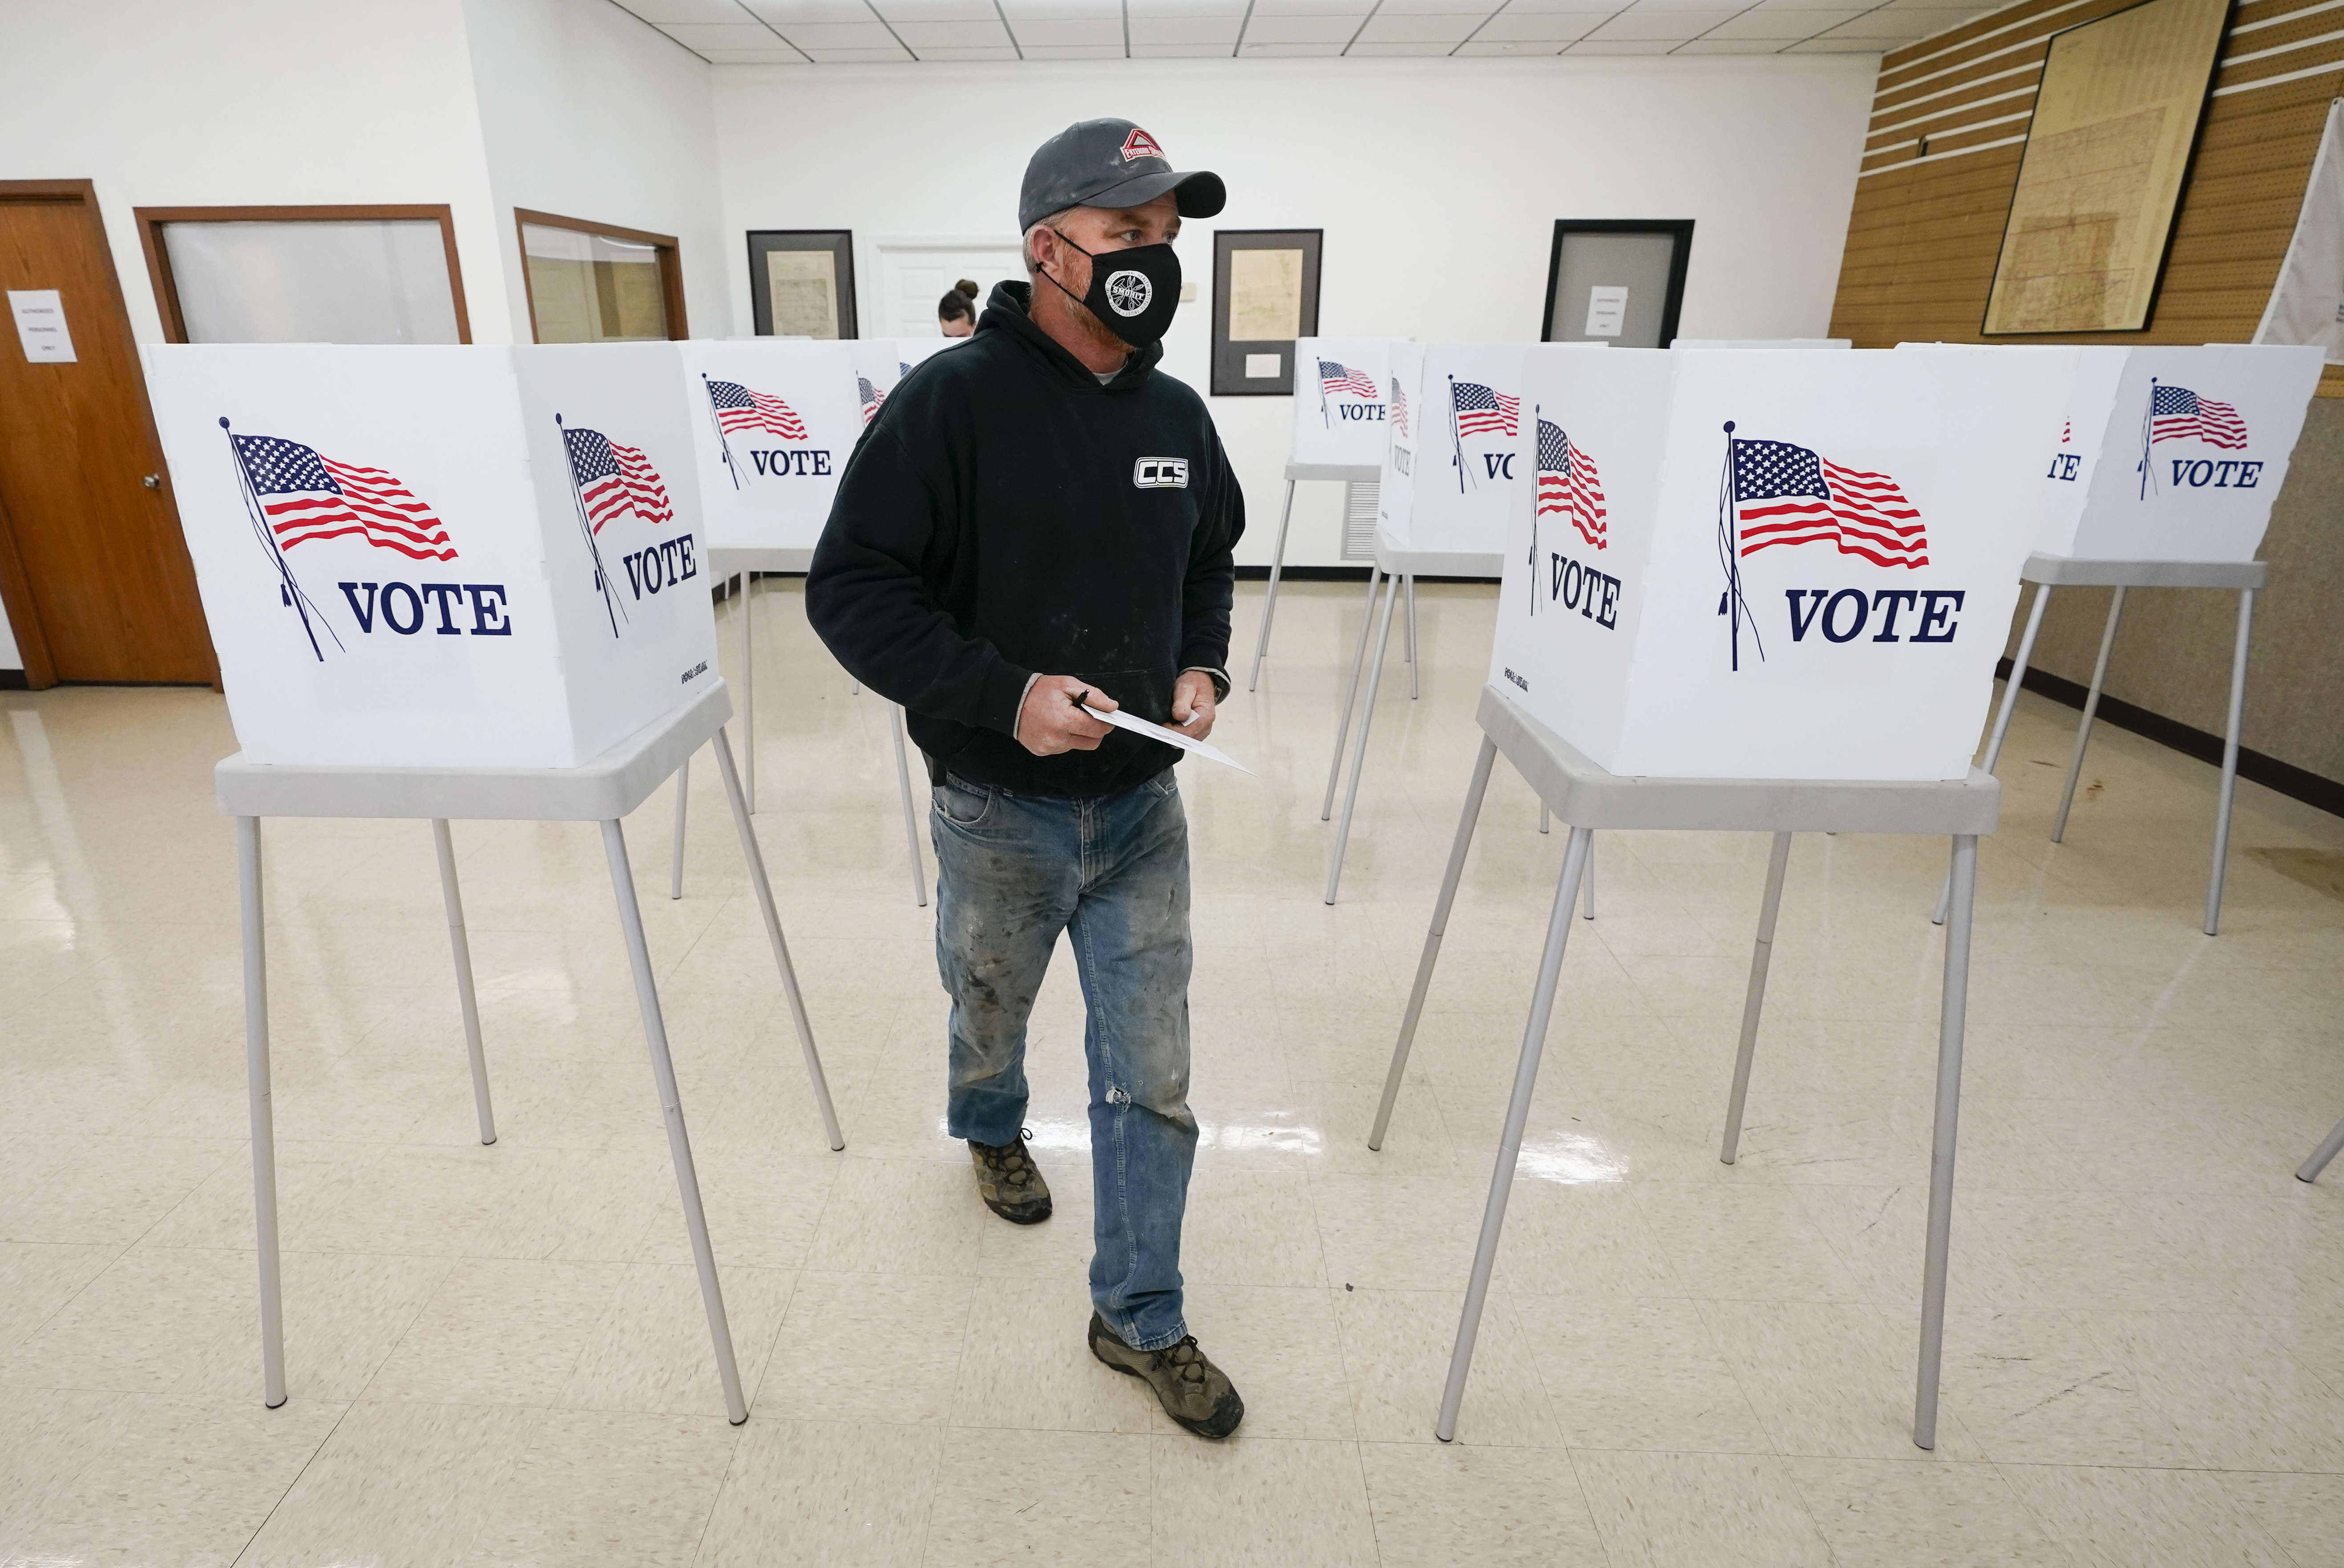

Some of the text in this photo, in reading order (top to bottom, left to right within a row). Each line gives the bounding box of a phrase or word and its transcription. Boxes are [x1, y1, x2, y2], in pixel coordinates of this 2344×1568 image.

[1138, 274, 1149, 287] HEALTH
[1140, 288, 1151, 311] INSTITUTE
[750, 450, 831, 476] VOTE
[1138, 461, 1186, 484] CCS
[2047, 453, 2081, 481] TE
[2172, 460, 2264, 488] VOTE
[623, 534, 697, 601] VOTE
[1551, 552, 1621, 631] VOTE
[338, 582, 512, 636] VOTE
[1785, 588, 1966, 643] VOTE
